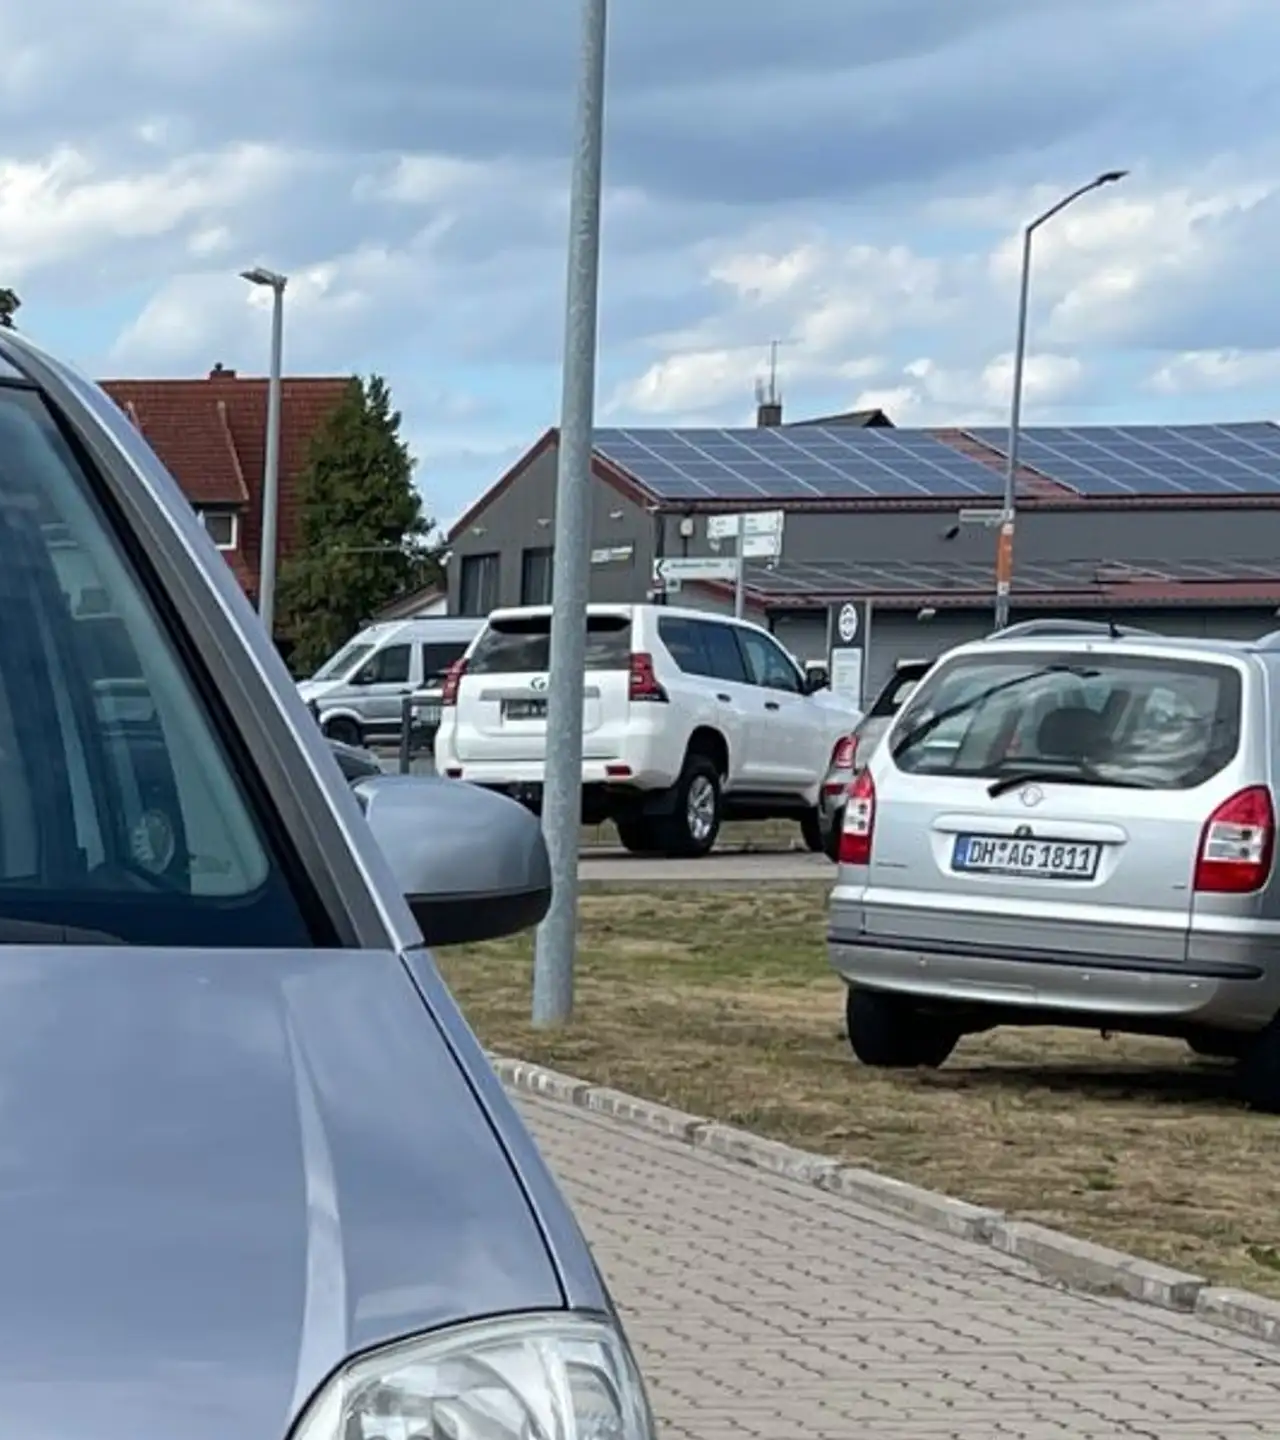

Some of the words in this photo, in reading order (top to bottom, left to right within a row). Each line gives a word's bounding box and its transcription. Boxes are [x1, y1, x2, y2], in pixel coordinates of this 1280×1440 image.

[969, 840, 996, 863] DH
[1007, 844, 1034, 866] AG
[1037, 845, 1090, 871] 1811
